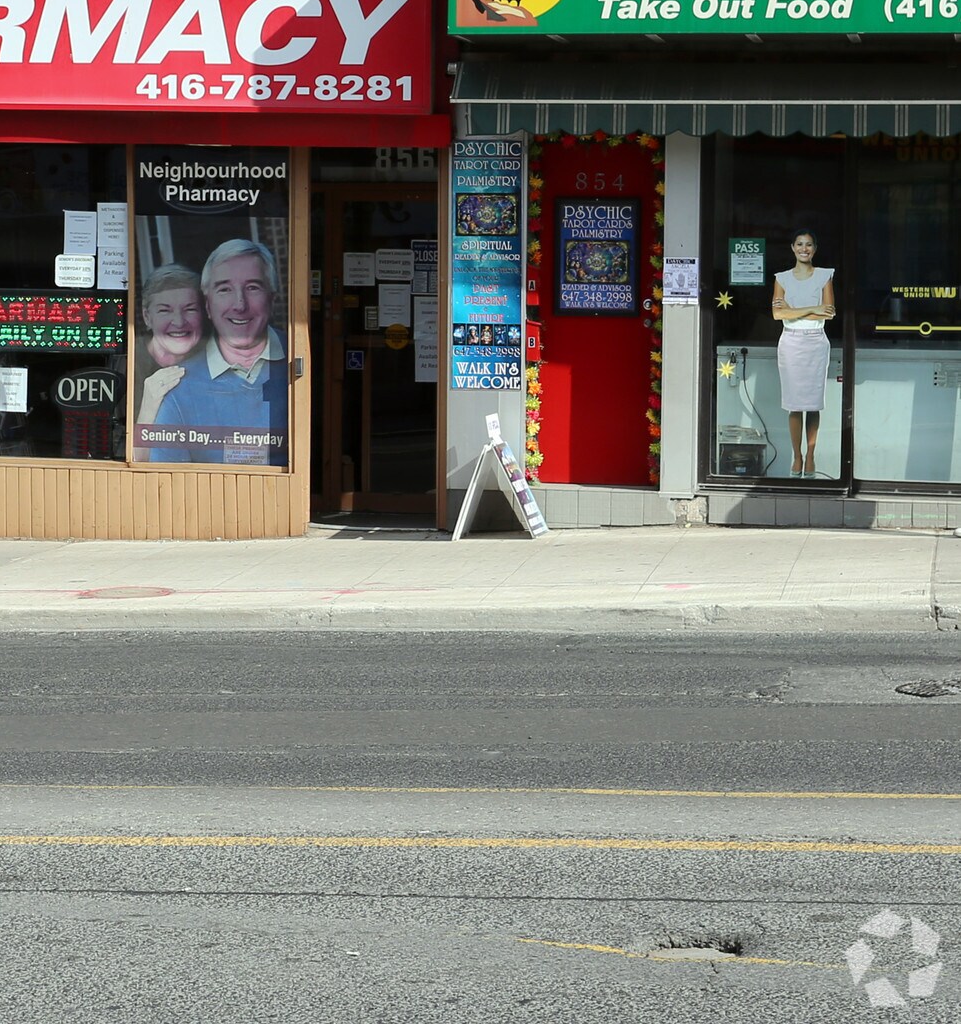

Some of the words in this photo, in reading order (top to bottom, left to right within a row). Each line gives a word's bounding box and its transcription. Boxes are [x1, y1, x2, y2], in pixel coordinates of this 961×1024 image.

[135, 73, 413, 102] 416-787-8281
[454, 142, 521, 156] PSYCHIC
[375, 147, 435, 172] 856
[454, 160, 489, 170] TAROT
[491, 160, 521, 170] CARD
[140, 162, 286, 183] Neighbourhood
[457, 176, 518, 187] PALMISTRY
[575, 172, 625, 191] 854
[165, 185, 260, 206] Pharmacy
[564, 206, 632, 220] PSYCHIC
[562, 219, 596, 229] TAROT
[597, 219, 633, 229] CARDS
[571, 229, 623, 239] PALMISTRY
[461, 240, 513, 251] SPIRITUAL
[734, 243, 760, 253] PASS
[473, 285, 499, 294] PAST
[529, 281, 535, 290] A
[598, 284, 632, 292] ADVISOR
[464, 296, 508, 306] PRESENT
[561, 291, 633, 302] 647-348-2998
[469, 314, 505, 323] FUTURE
[52, 326, 81, 342] ON
[529, 338, 535, 347] B
[456, 362, 493, 375] WALK
[494, 362, 519, 375] IN'S
[454, 376, 521, 389] WELCOME
[57, 377, 114, 402] OPEN
[141, 429, 186, 443] Senior's
[233, 432, 284, 448] Everyday
